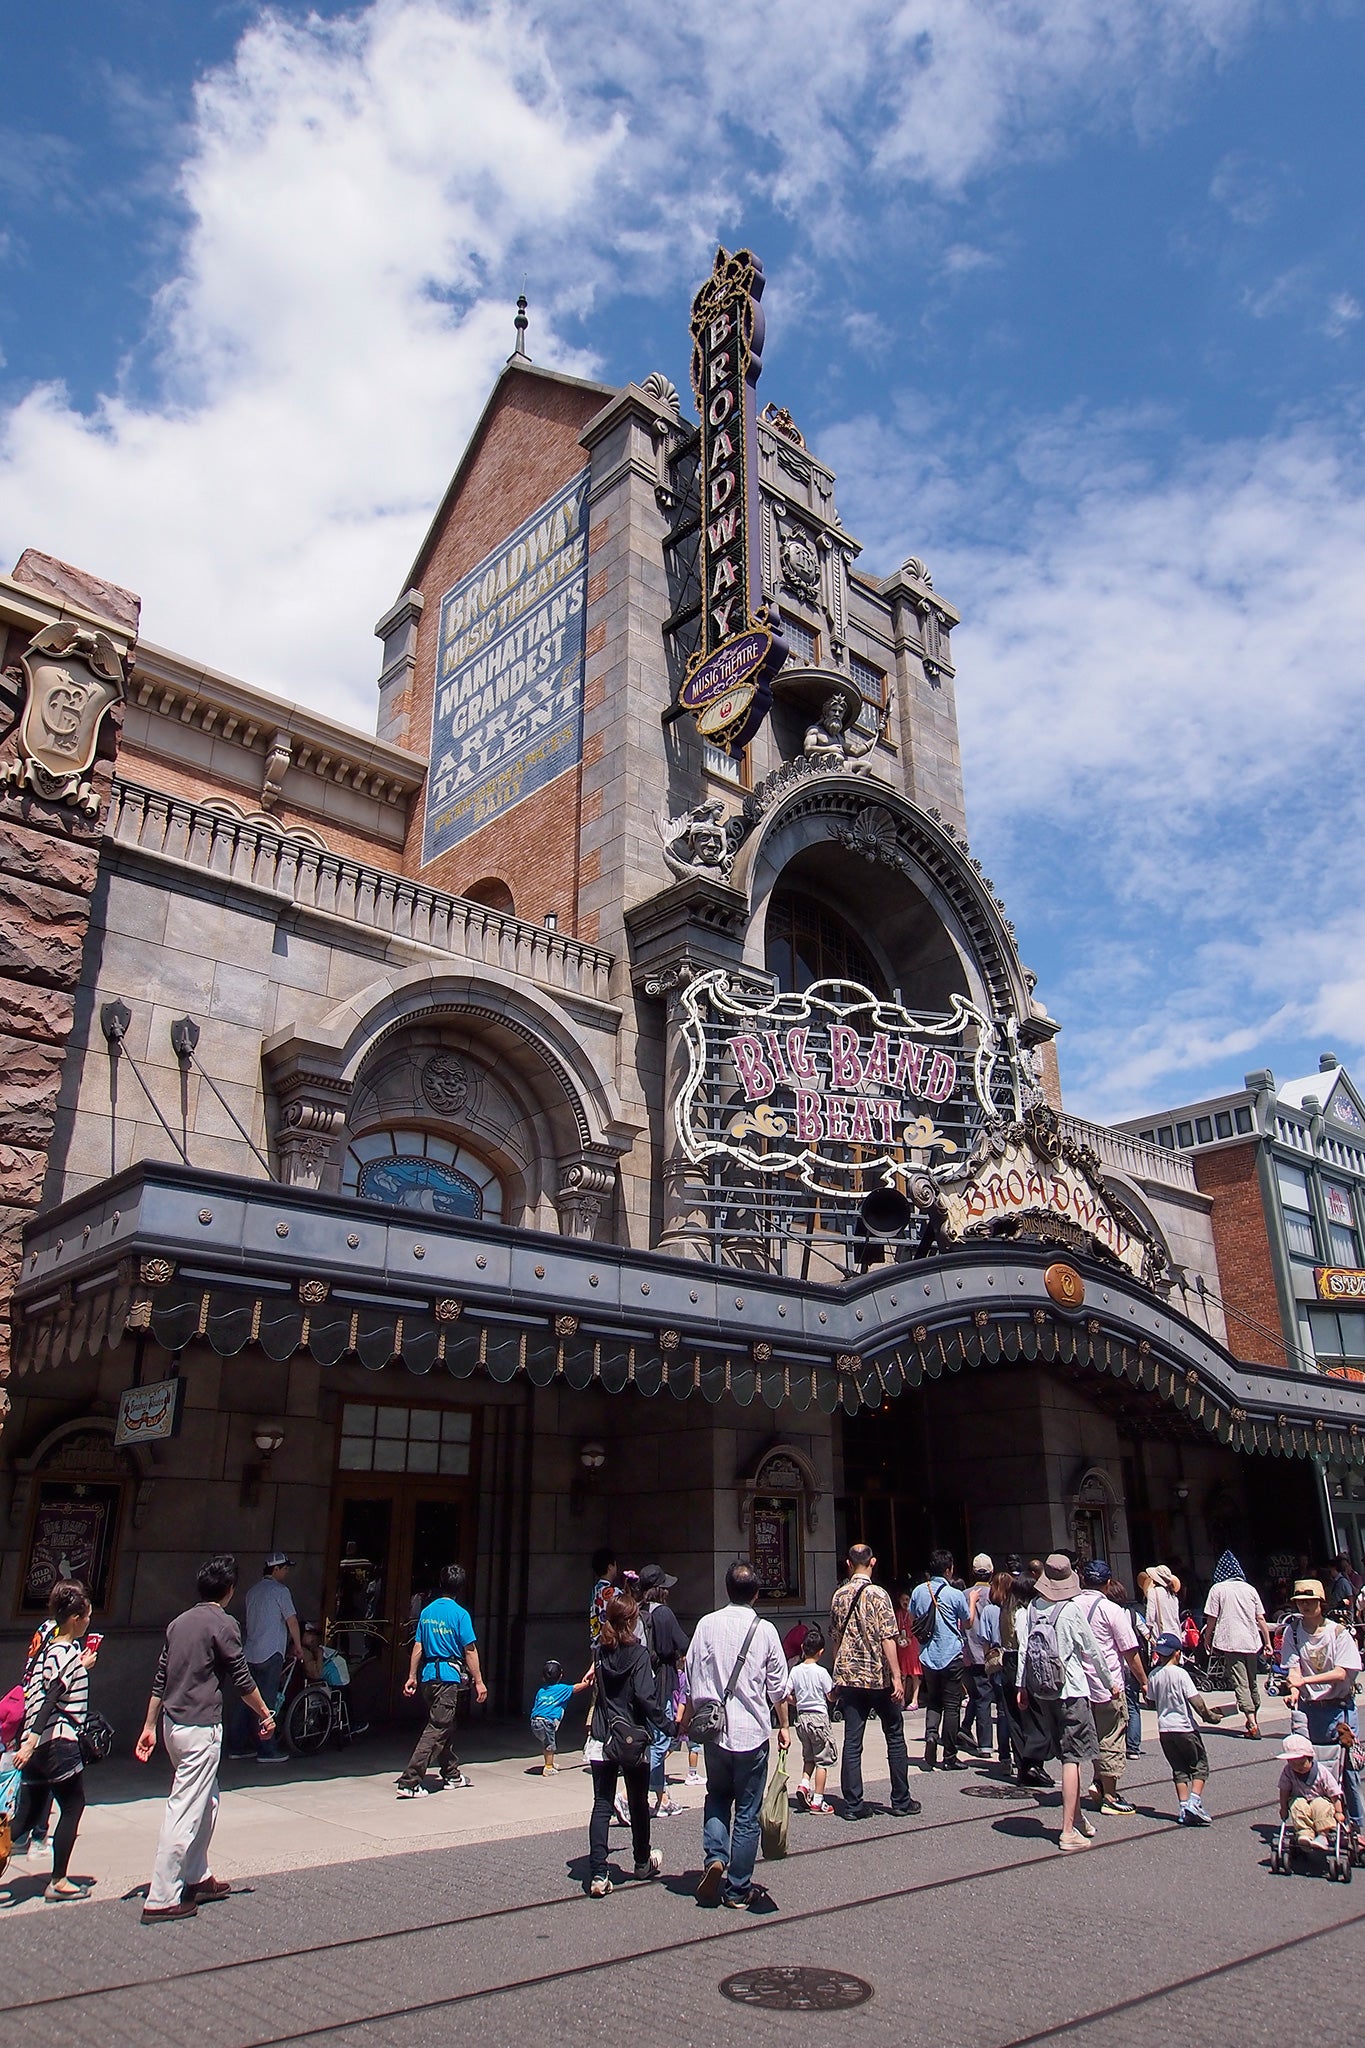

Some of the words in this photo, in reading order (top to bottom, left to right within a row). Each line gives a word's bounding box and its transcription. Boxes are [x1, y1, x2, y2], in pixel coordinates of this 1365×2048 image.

[707, 312, 741, 641] BROADWAY
[443, 609, 498, 677] MUSIC
[498, 532, 586, 629] THEATRE
[445, 485, 588, 643] BROADWAY
[438, 577, 585, 721] MANHATTAN'S
[452, 627, 566, 739] GRANDEST
[691, 668, 720, 700] MUSIC
[719, 642, 759, 680] THEATRE
[432, 666, 564, 782] ARRAY
[432, 679, 581, 803] TALENT
[434, 724, 574, 832] PERFORMANCES
[473, 778, 524, 824] DAILY
[726, 1026, 817, 1103] BIG
[826, 1023, 957, 1103] BAND
[793, 1087, 901, 1145] BEAT
[957, 1168, 1131, 1257] BROADWAY
[1023, 1217, 1048, 1236] MUSIC
[1051, 1218, 1084, 1244] THEATRE
[31, 1574, 53, 1587] OVER
[32, 1568, 50, 1580] HELD
[1271, 1553, 1296, 1567] BOX
